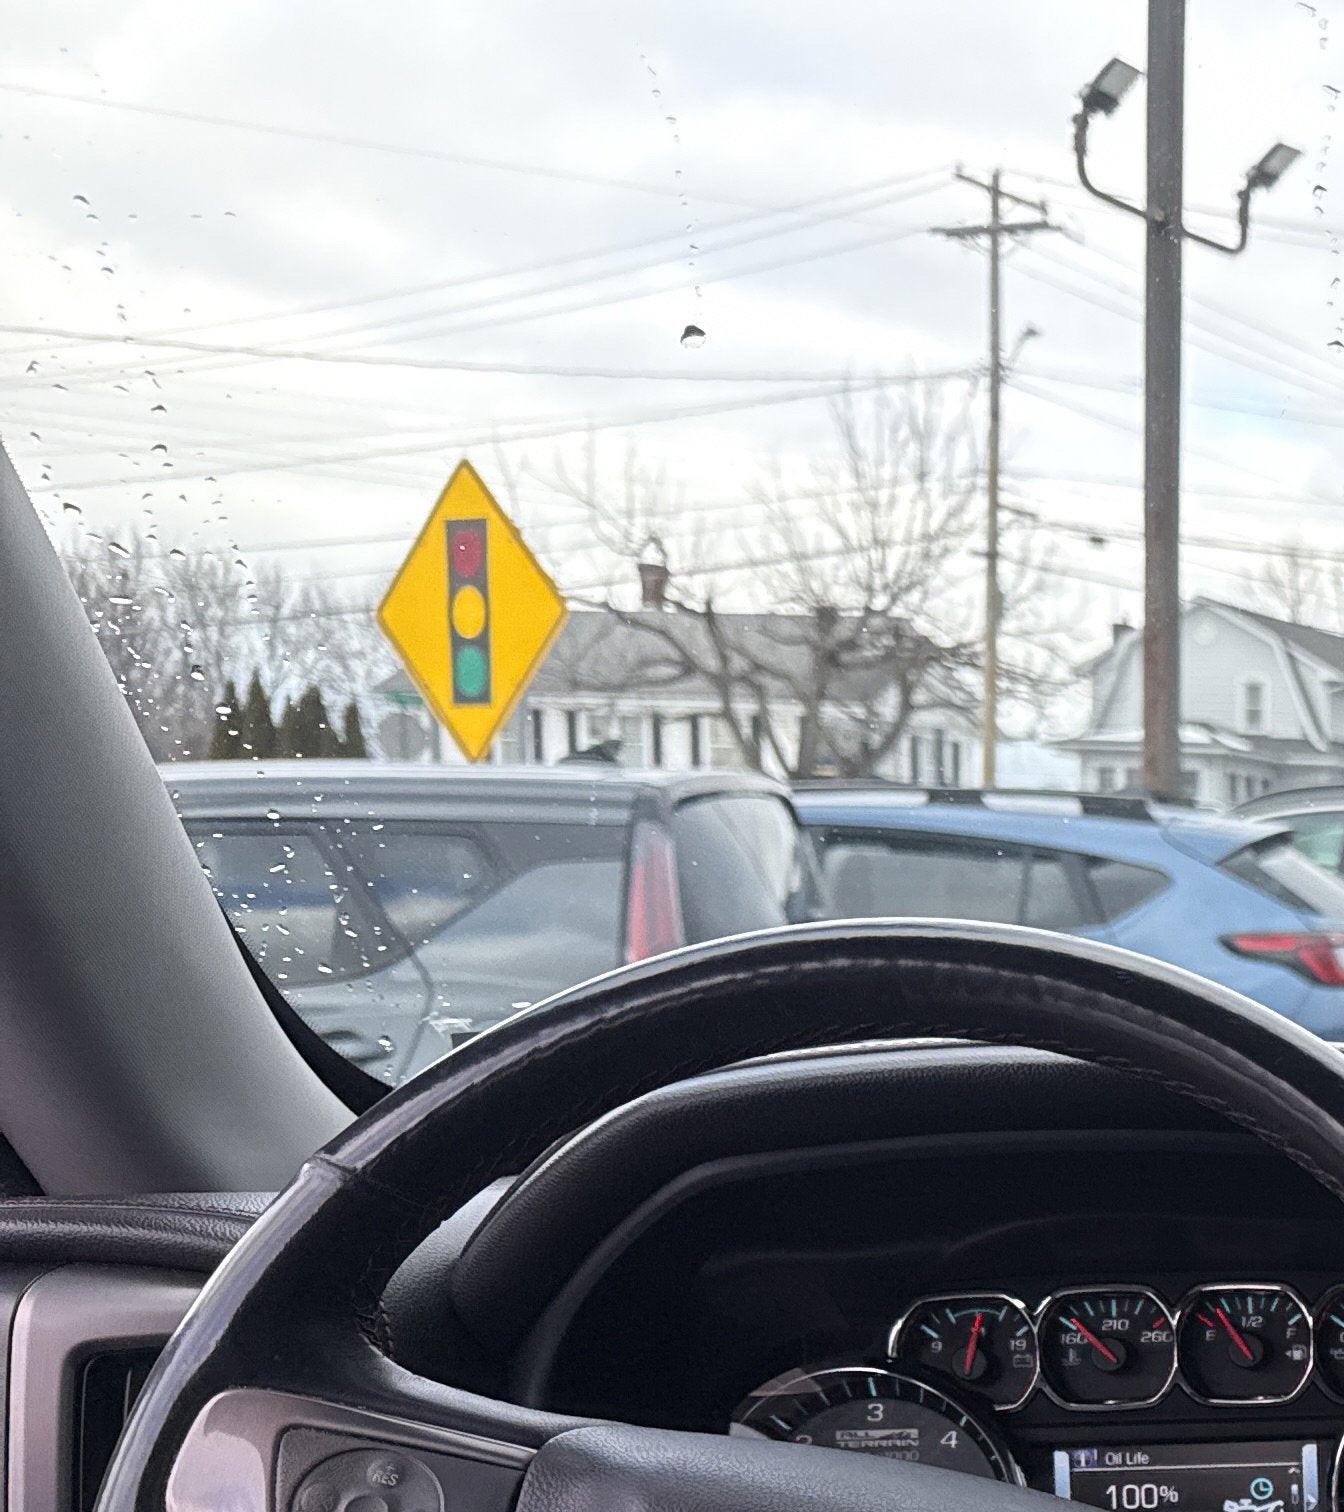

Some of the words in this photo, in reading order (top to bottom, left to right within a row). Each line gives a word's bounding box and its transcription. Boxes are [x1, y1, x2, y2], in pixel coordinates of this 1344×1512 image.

[1101, 1319, 1129, 1331] 210
[1140, 1331, 1173, 1344] 260
[1206, 1330, 1216, 1342] E
[1286, 1328, 1296, 1339] F
[931, 1341, 942, 1352] 9
[1010, 1340, 1026, 1350] 19
[867, 1403, 884, 1422] 3
[940, 1430, 959, 1449] 4
[1105, 1452, 1122, 1466] Oil
[1126, 1451, 1150, 1465] Life
[1105, 1484, 1179, 1510] 100%
